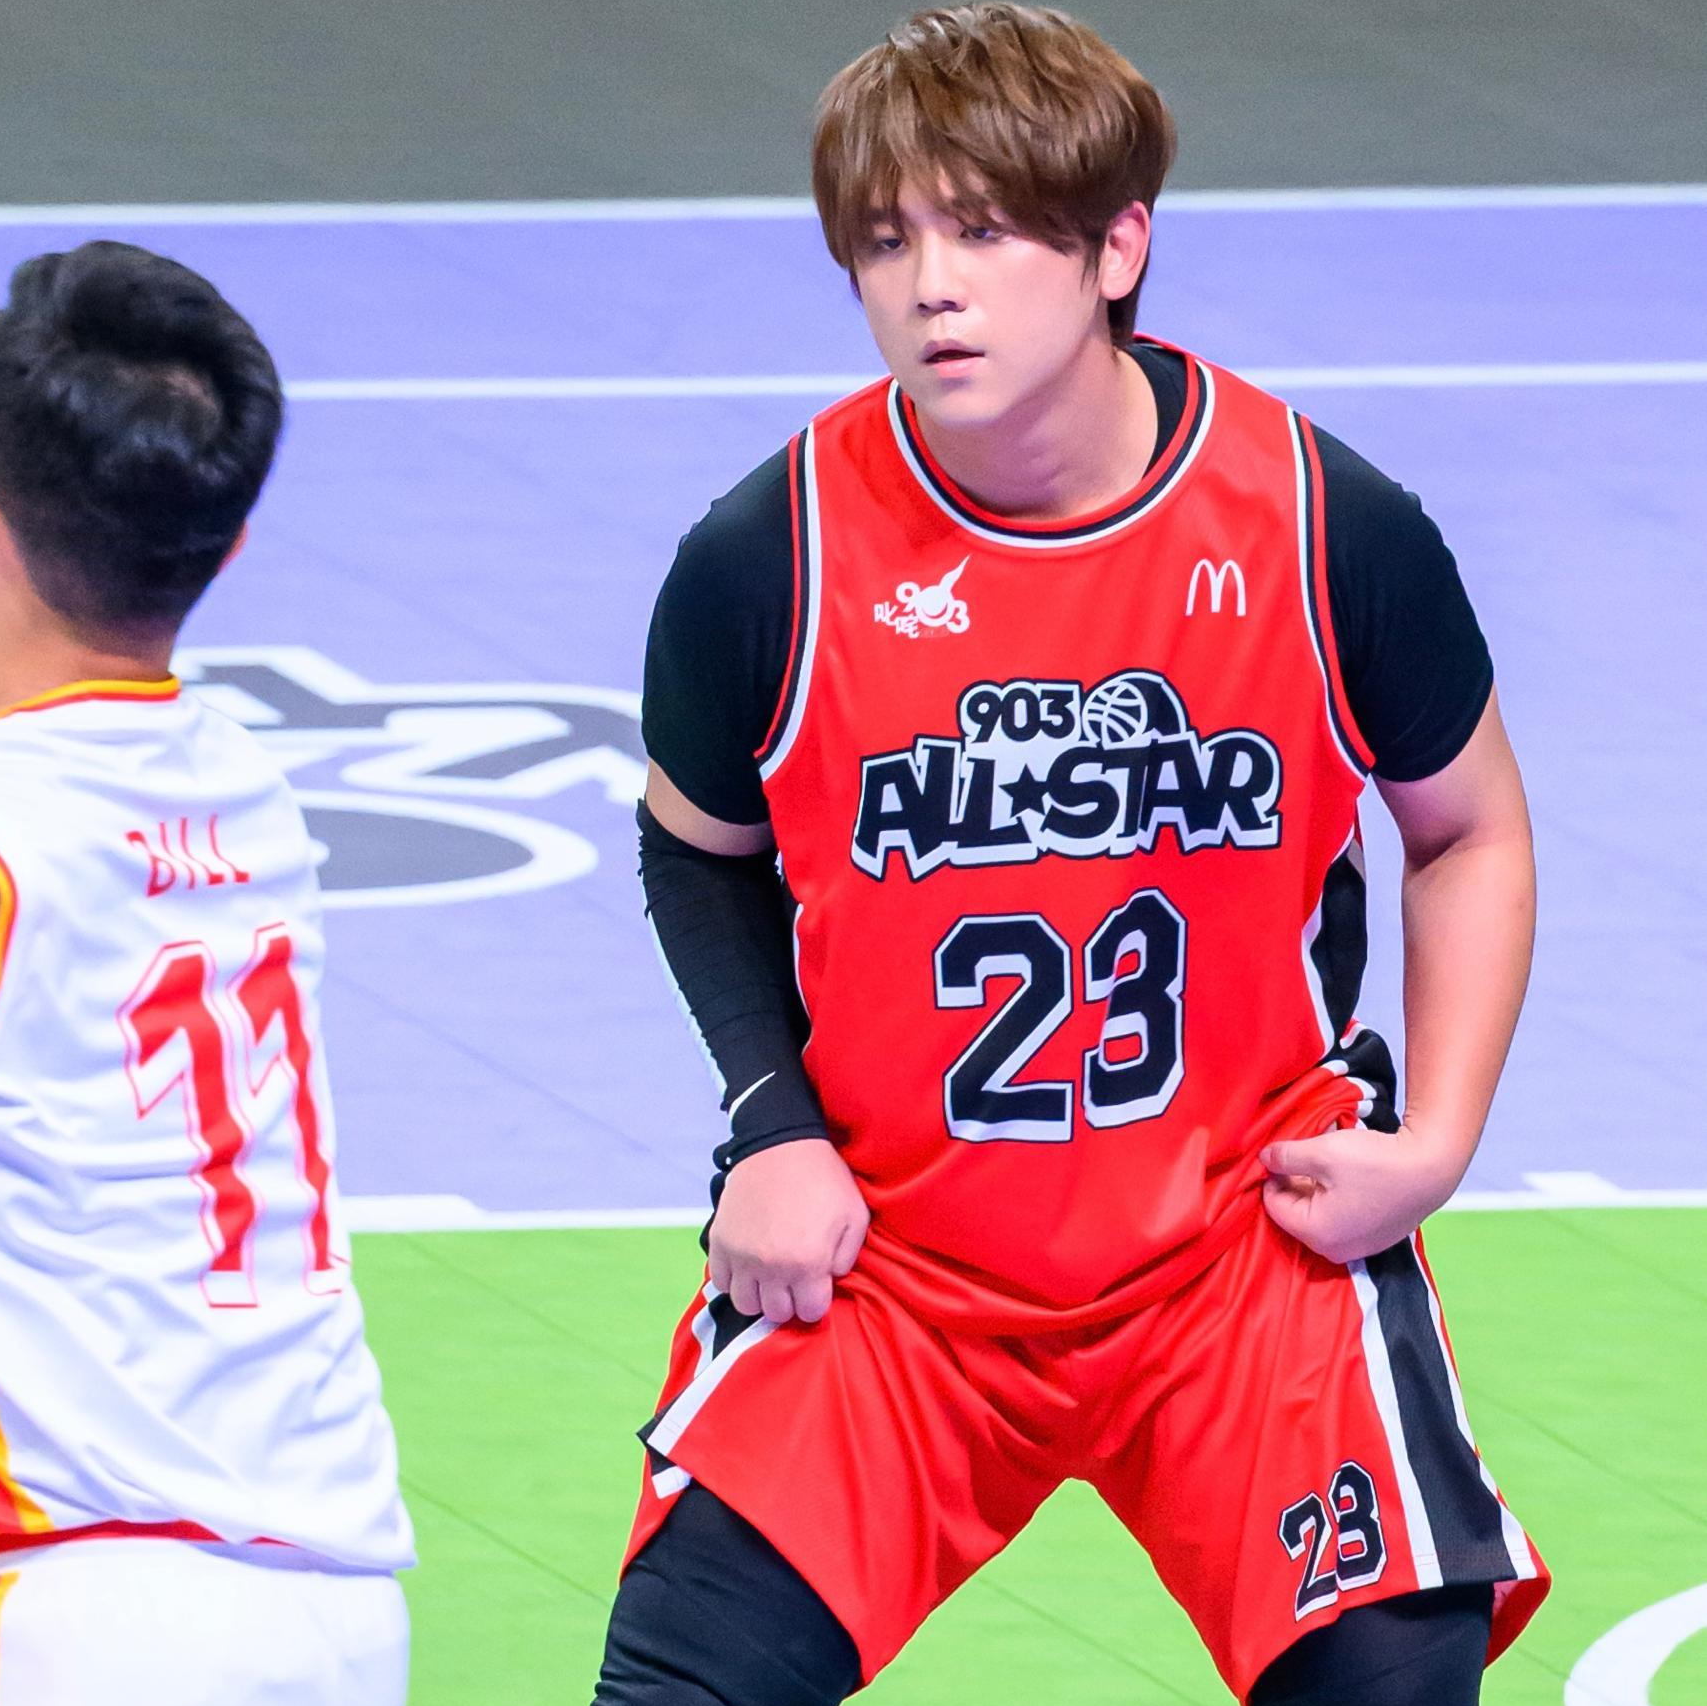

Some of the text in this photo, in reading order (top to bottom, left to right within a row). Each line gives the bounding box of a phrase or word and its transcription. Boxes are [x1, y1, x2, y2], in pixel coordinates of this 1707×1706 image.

[962, 684, 1080, 744] 903
[116, 922, 351, 1309] 11
[932, 887, 1187, 1142] 23
[1277, 1459, 1388, 1624] 23
